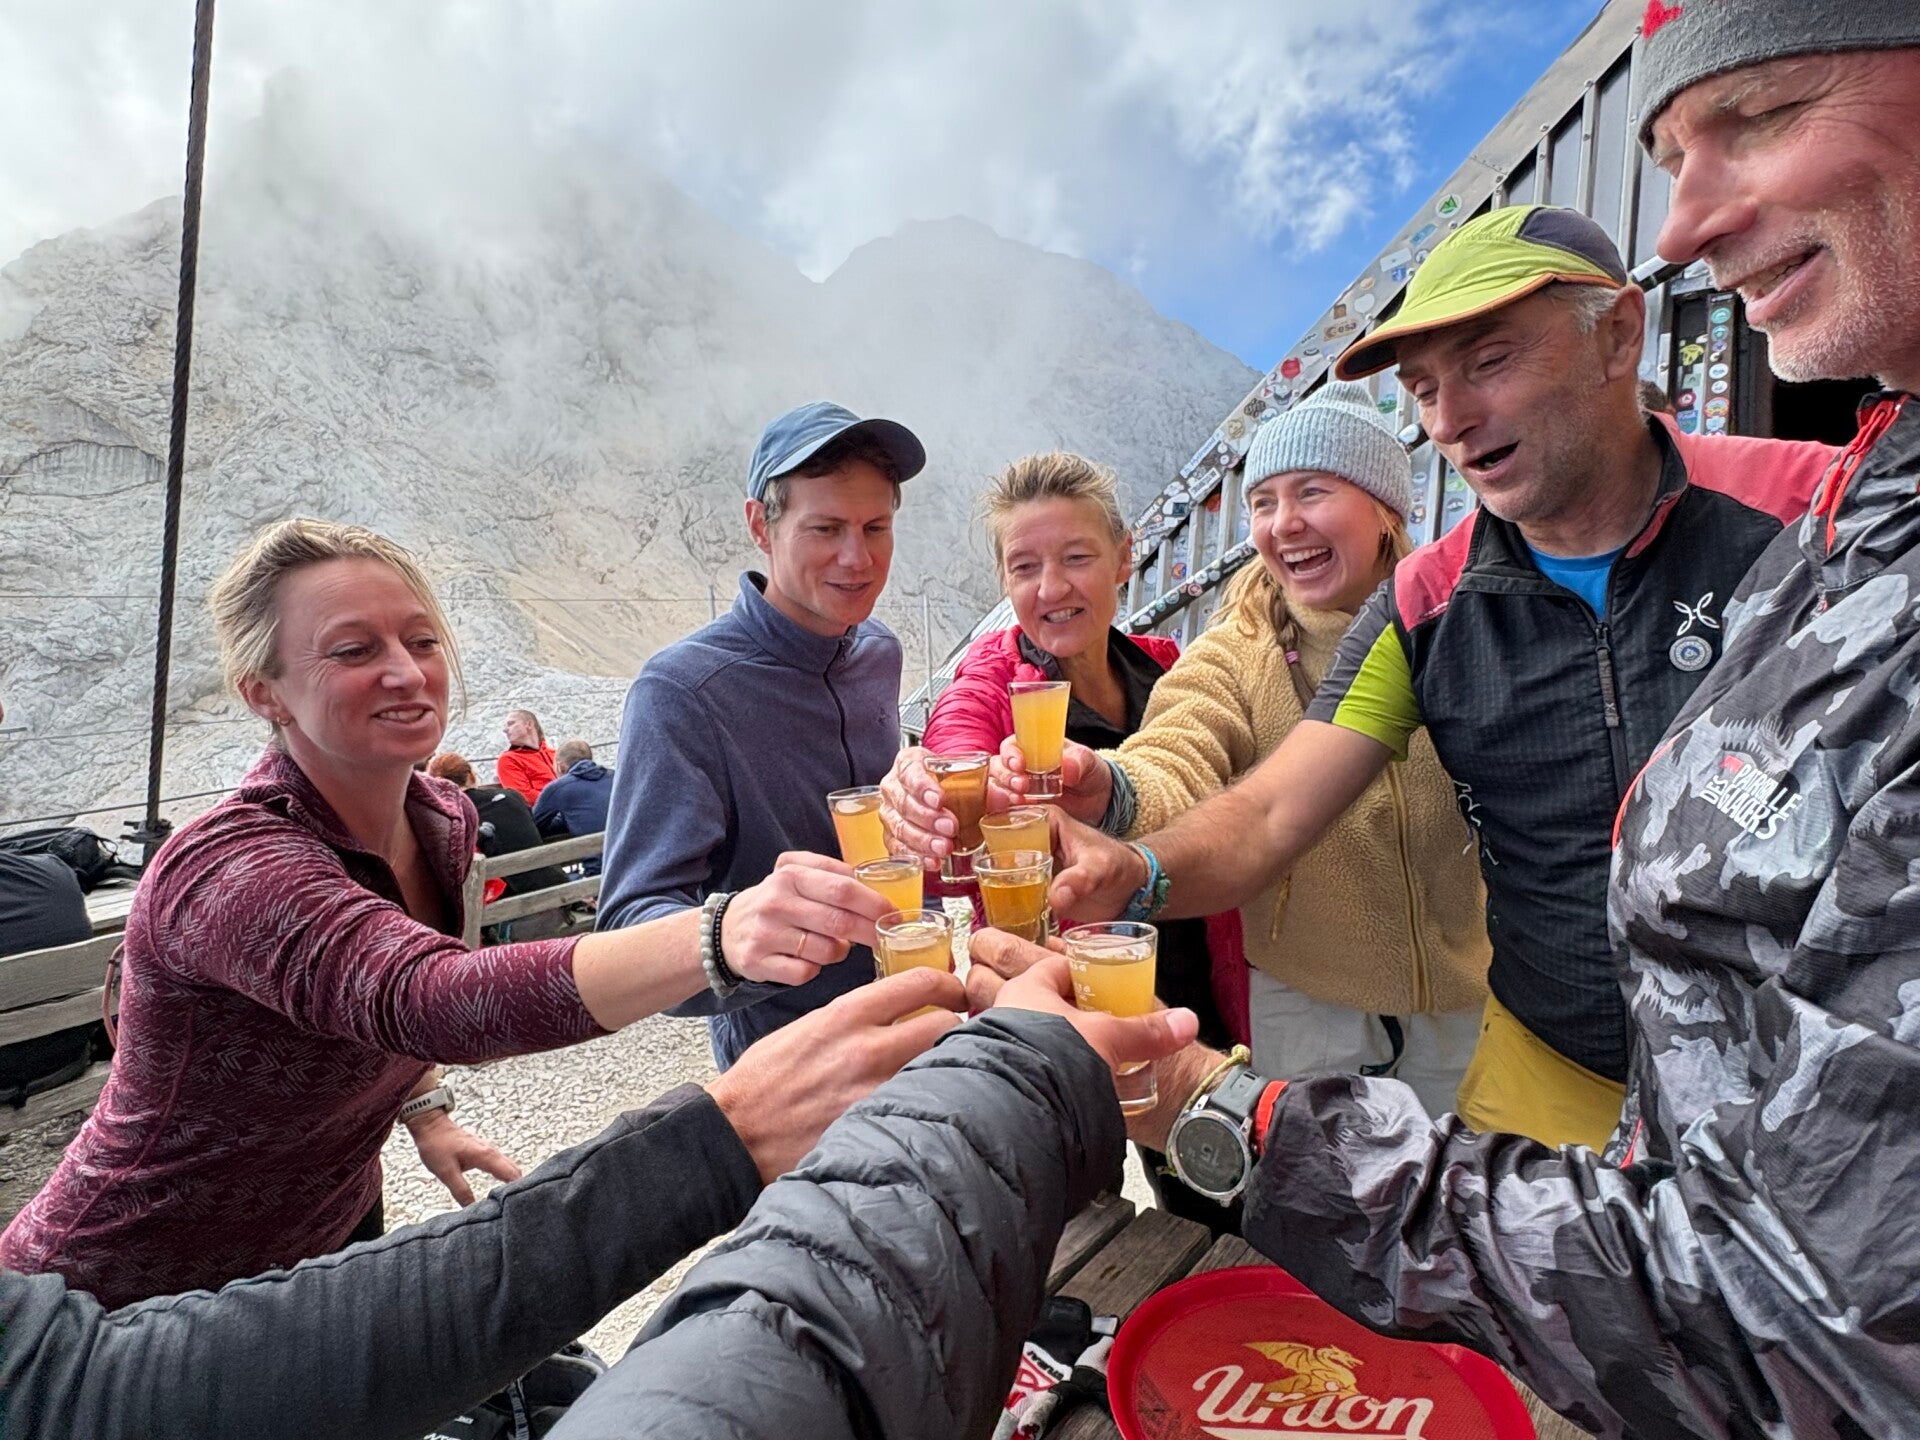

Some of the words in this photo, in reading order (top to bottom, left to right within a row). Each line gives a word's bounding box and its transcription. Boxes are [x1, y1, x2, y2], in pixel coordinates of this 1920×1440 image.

[1700, 775, 1729, 805] DES
[1717, 784, 1787, 840] GLACERS
[1192, 1365, 1434, 1432] Union
